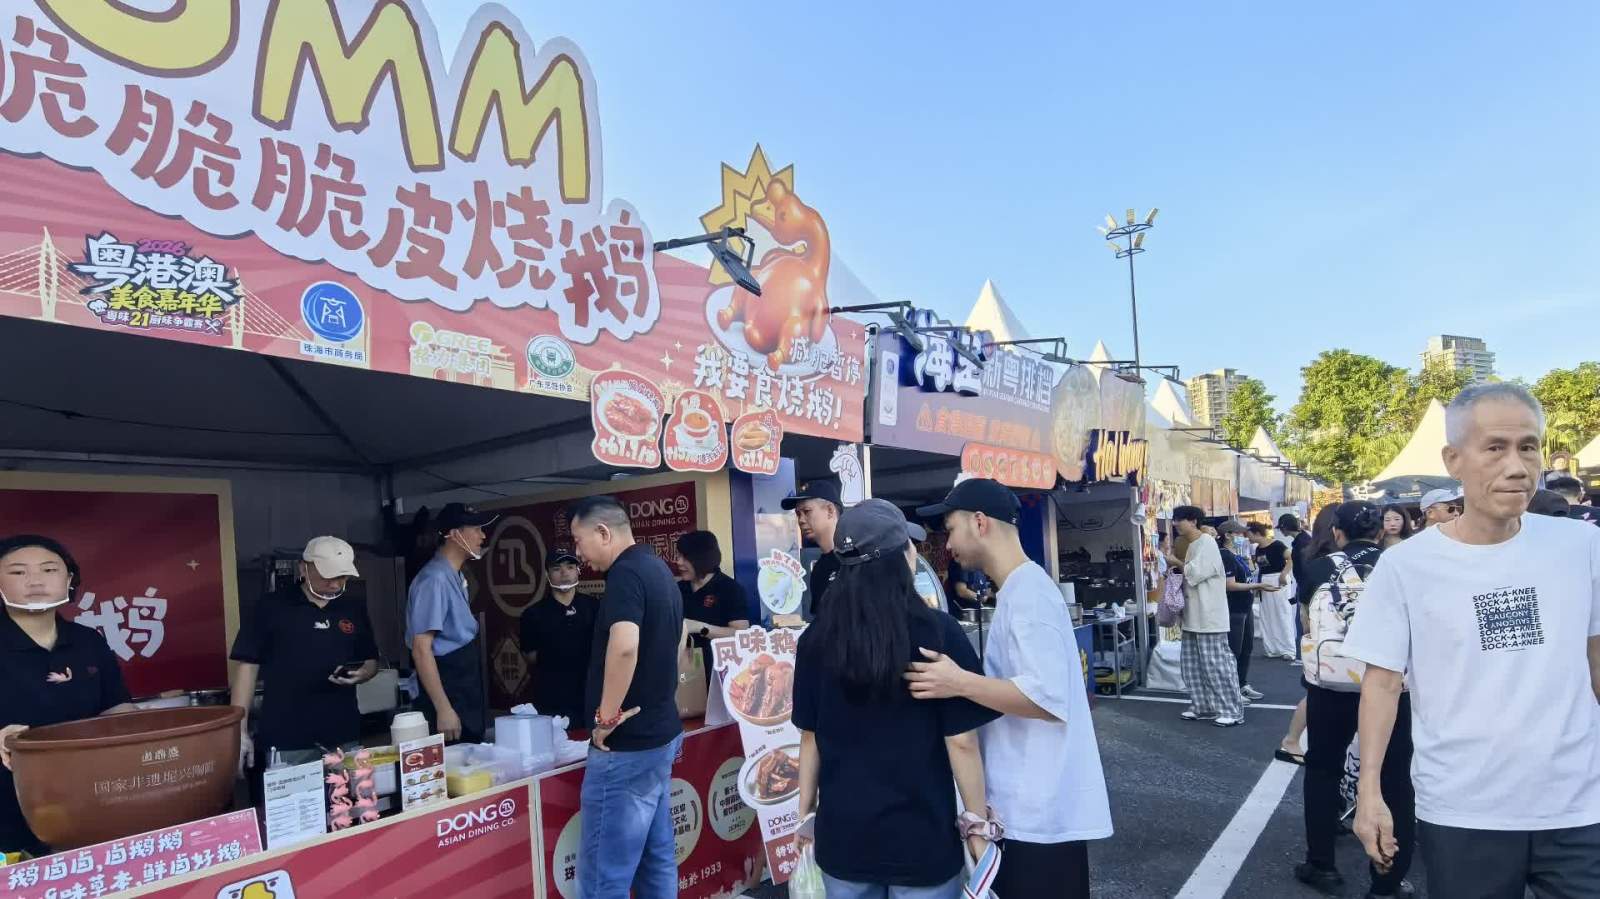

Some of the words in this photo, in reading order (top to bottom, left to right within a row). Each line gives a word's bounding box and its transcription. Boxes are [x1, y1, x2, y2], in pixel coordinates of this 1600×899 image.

[138, 239, 186, 255] 2026
[72, 232, 235, 303] 粤港澳
[110, 284, 223, 318] 美食嘉年华
[630, 498, 674, 519] DONG
[1472, 587, 1536, 602] SOCK-A-KNEE
[1474, 594, 1538, 609] SOCK-A-KNEE
[1480, 630, 1544, 644] SOCK-A-KNEE
[1481, 637, 1545, 651] SOCK-A-KNEE
[436, 804, 498, 837] DONG
[438, 832, 466, 848] ASIAN
[468, 822, 500, 838] DINING
[701, 861, 722, 880] 1933
